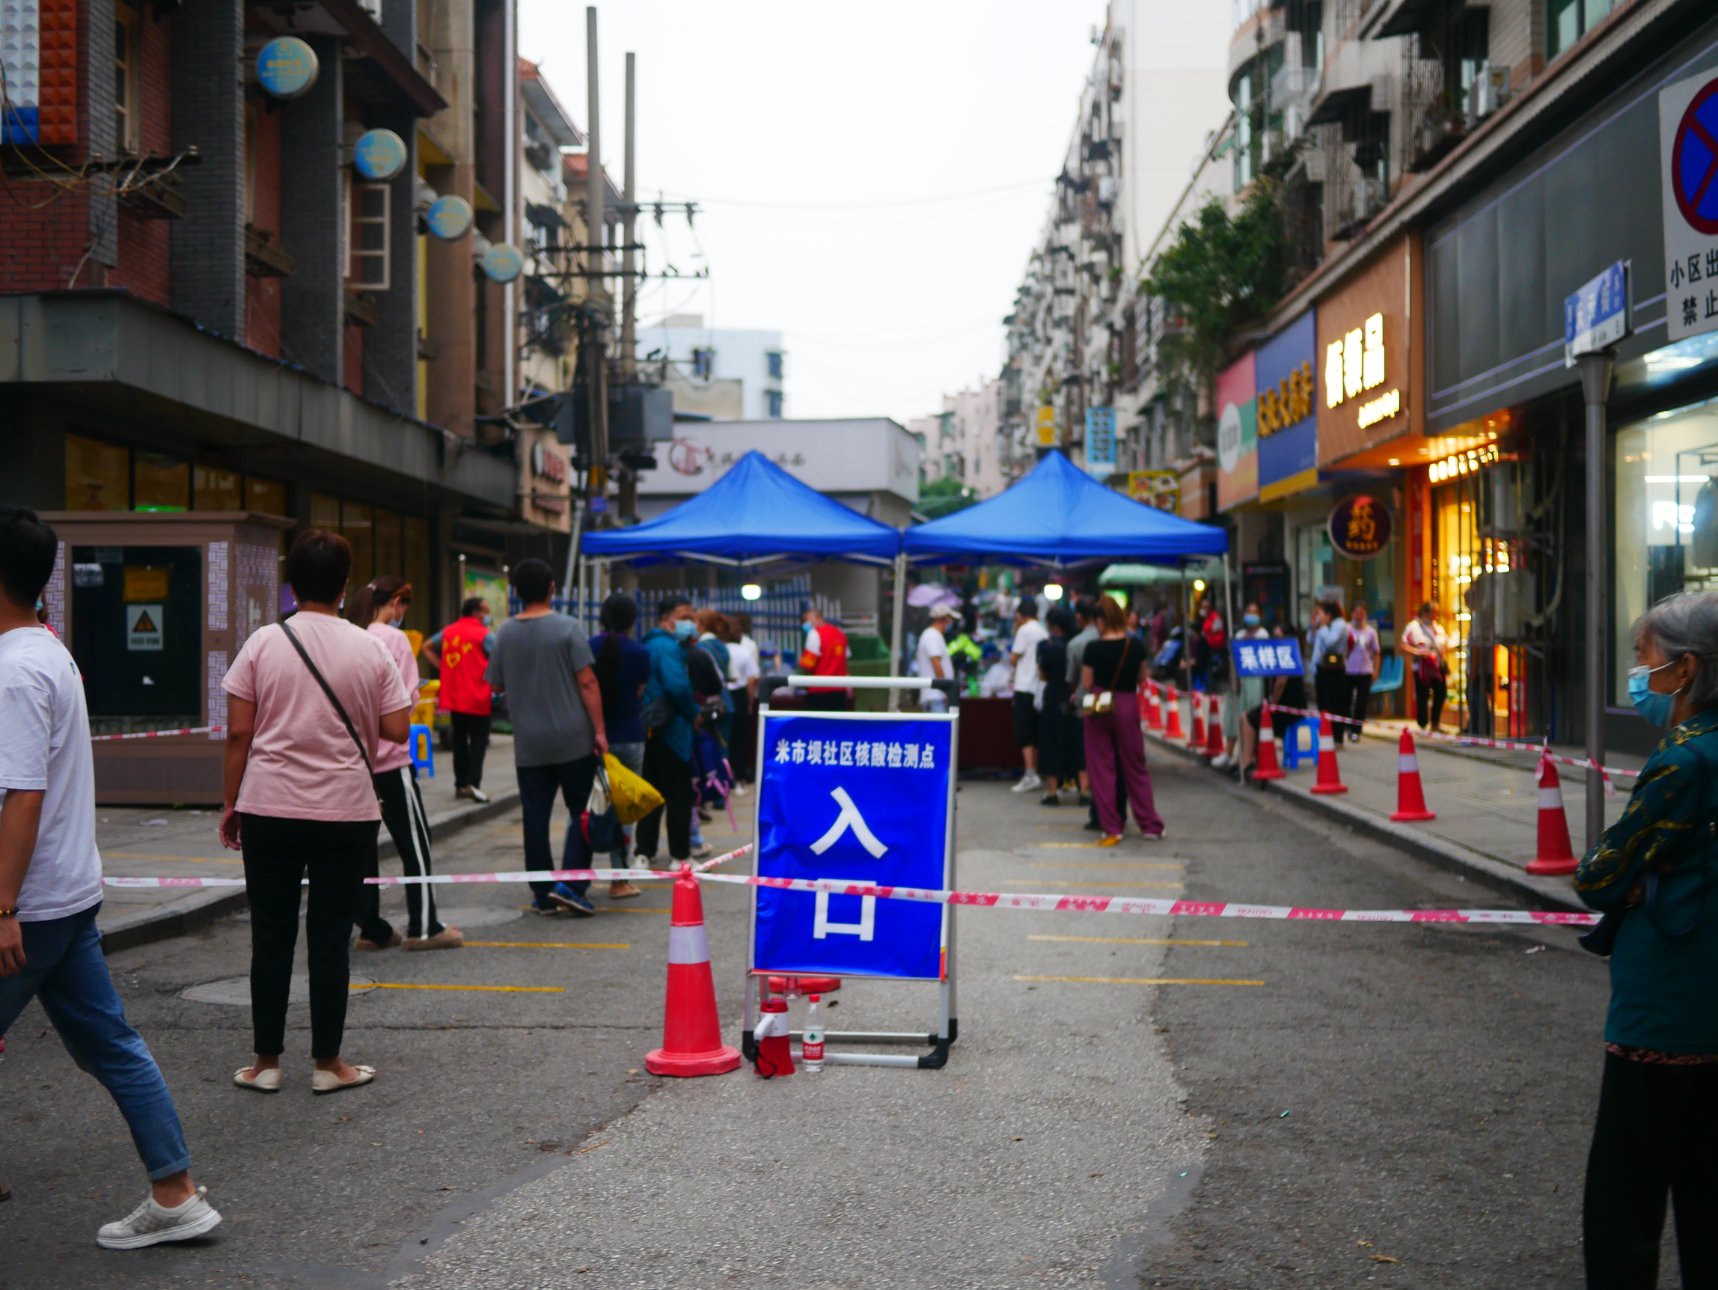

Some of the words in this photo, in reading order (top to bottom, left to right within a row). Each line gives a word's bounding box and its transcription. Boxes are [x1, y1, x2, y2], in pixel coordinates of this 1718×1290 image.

[1670, 248, 1718, 289] 小区出
[1682, 289, 1718, 327] 禁止
[1239, 645, 1297, 671] 采样区
[774, 739, 936, 769] 米市坝社区核酸检测点
[810, 786, 888, 941] 入口
